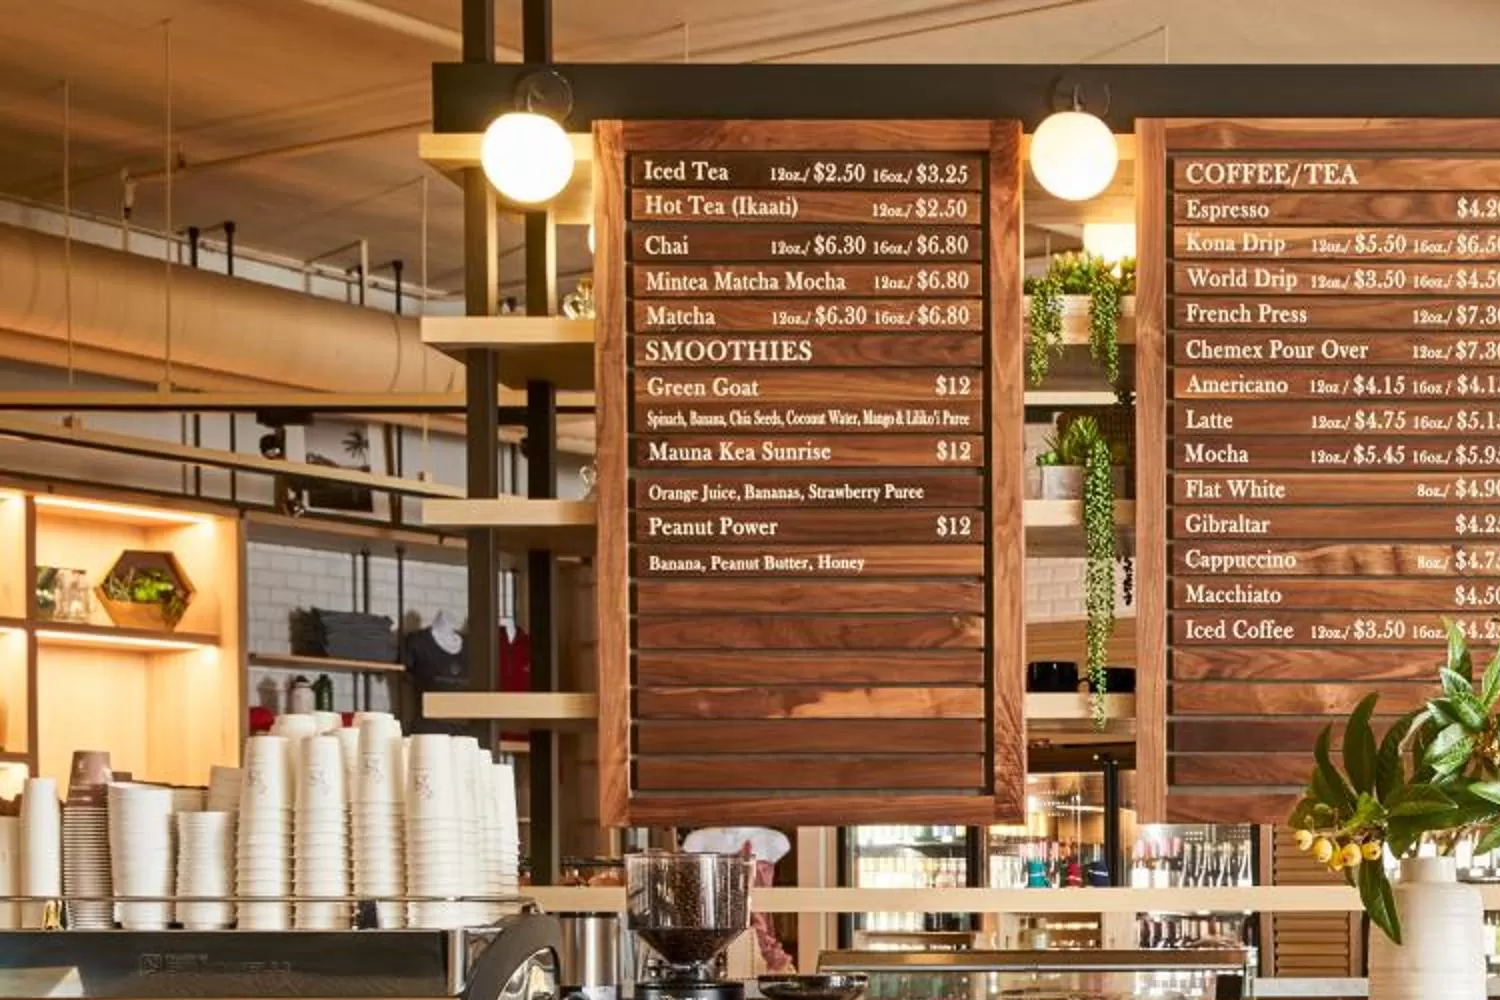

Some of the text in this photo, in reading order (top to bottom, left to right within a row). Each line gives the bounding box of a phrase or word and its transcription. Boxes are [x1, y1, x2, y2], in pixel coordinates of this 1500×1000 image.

[645, 161, 685, 180] Iced
[692, 162, 728, 180] Tea
[814, 162, 865, 183] $2.50
[916, 164, 967, 184] $3.25
[1186, 163, 1358, 187] COFFEE/TEA
[646, 195, 682, 214] Hot
[688, 196, 725, 214] Tea
[732, 196, 798, 218] (Ikaati)
[916, 198, 966, 218] $2.50
[1187, 199, 1269, 222] Espresso
[645, 236, 688, 254] Chai
[814, 235, 866, 255] $6.30
[917, 235, 968, 255] $6.80
[1186, 233, 1236, 252] Kona
[1242, 232, 1286, 255] Drip
[1355, 233, 1407, 254] $5.50
[647, 272, 708, 290] Mintea
[715, 272, 778, 290] Matcha
[786, 272, 846, 290] Mocha
[917, 270, 968, 290] $6.80
[1188, 268, 1247, 287] World
[1255, 268, 1297, 292] Drip
[1354, 269, 1406, 289] $3.50
[647, 306, 715, 324] Matcha
[816, 306, 866, 326] $6.30
[918, 305, 969, 325] $6.80
[1187, 304, 1251, 322] French
[1259, 304, 1307, 322] Press
[646, 340, 812, 361] SMOOTHIES
[1186, 340, 1262, 358] Chemex
[1270, 340, 1314, 358] Pour
[1322, 340, 1368, 358] Over
[648, 375, 970, 396] Green Goat $12
[1186, 375, 1288, 393] Americano
[1353, 374, 1404, 396] $4.15
[1186, 410, 1232, 428] Latte
[1355, 410, 1406, 430] $4.75
[650, 440, 970, 461] Mauna Kea Sunrise $12
[1186, 444, 1248, 462] Mocha
[1354, 444, 1404, 464] $5.45
[649, 484, 923, 502] Orange Juice, Bananas, Strawberry Puree
[1186, 480, 1221, 498] Flat
[1227, 480, 1285, 498] White
[650, 516, 970, 536] Peanut Power $12
[1186, 514, 1270, 533] Gibraltar
[650, 554, 864, 572] Banana, Peanut Butter, Honey
[1186, 550, 1296, 573] Cappuccino
[1186, 584, 1281, 603] Macchiato
[1186, 620, 1226, 638] Iced
[1233, 620, 1294, 639] Coffee
[1354, 619, 1405, 640] $3.50
